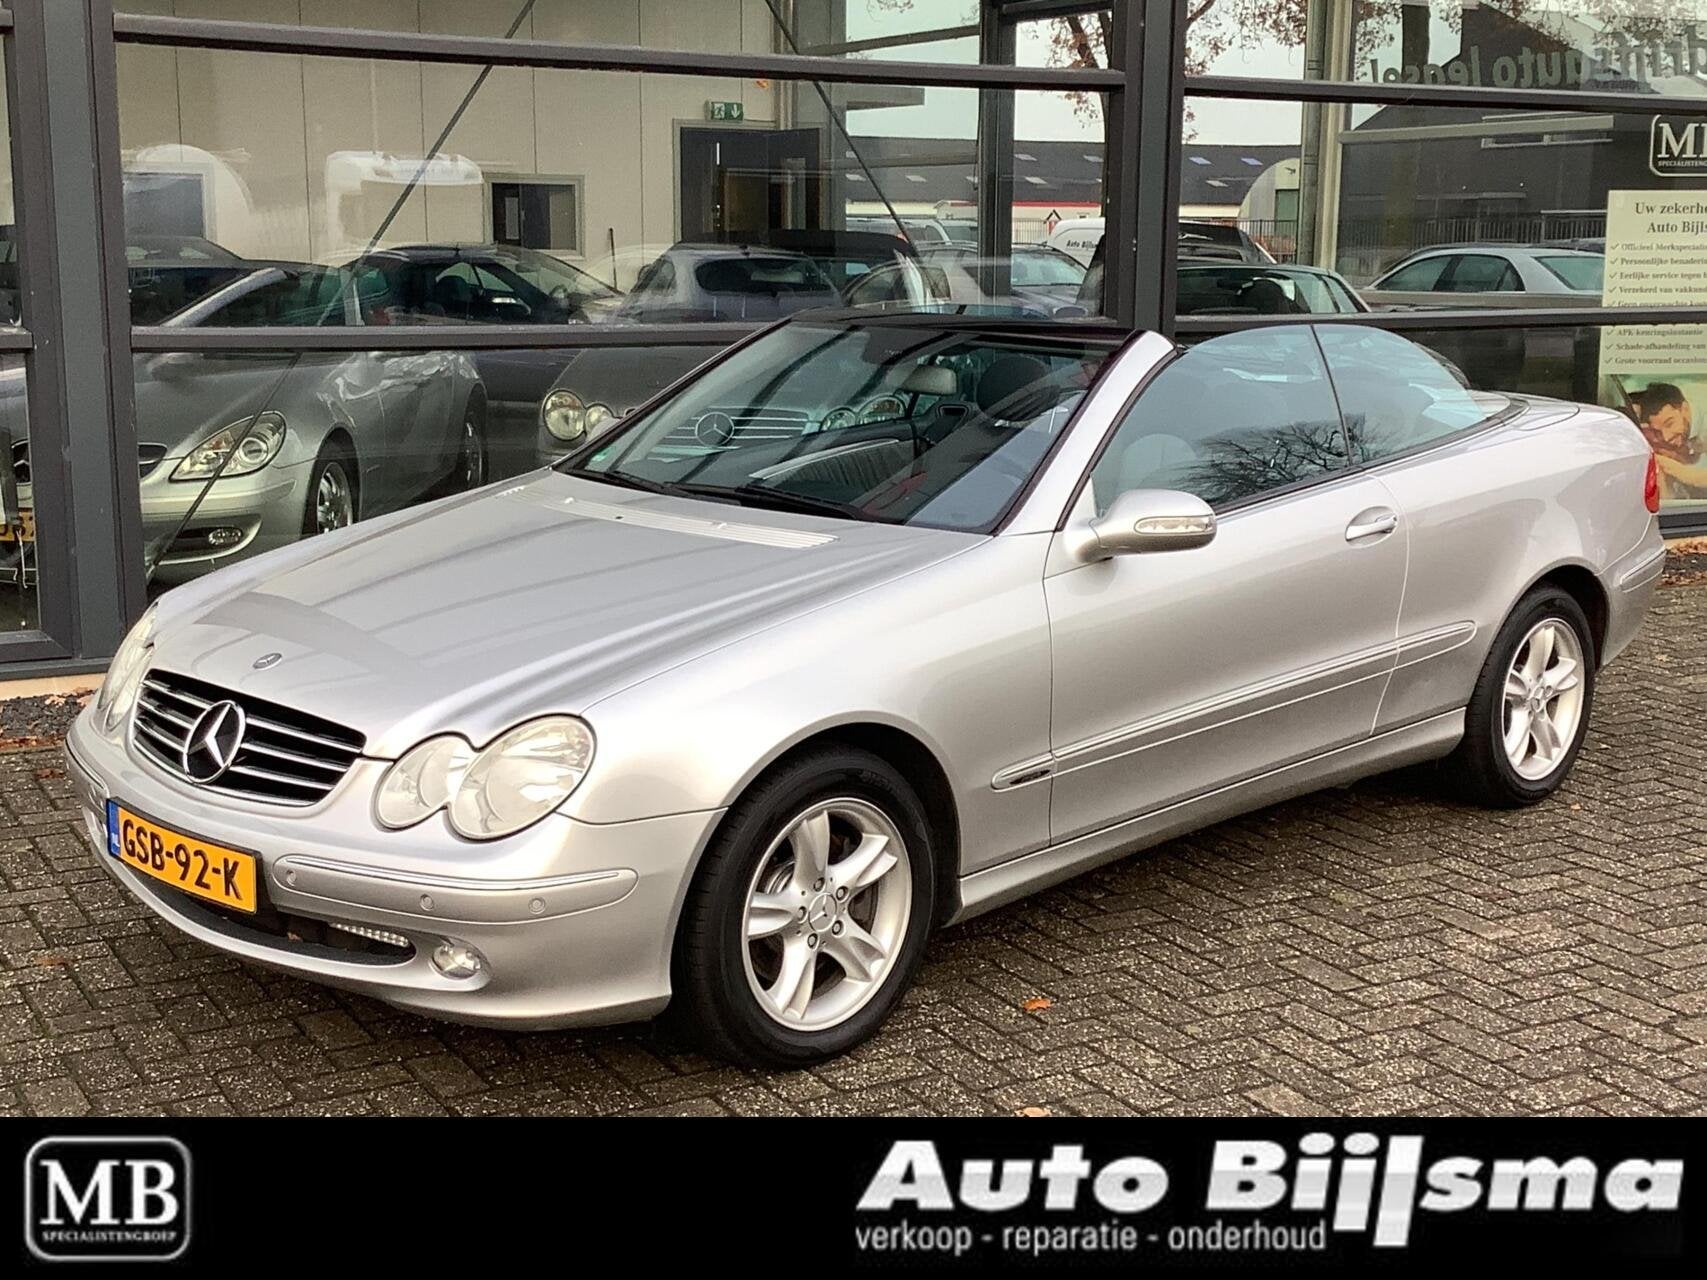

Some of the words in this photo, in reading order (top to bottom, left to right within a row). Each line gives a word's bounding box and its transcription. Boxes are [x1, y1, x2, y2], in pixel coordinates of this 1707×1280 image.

[1635, 202, 1655, 214] Uw
[1648, 221, 1678, 233] Auto
[1620, 272, 1650, 280] Eerlijke
[1680, 272, 1702, 280] tegen
[122, 818, 243, 901] GSB-92-K
